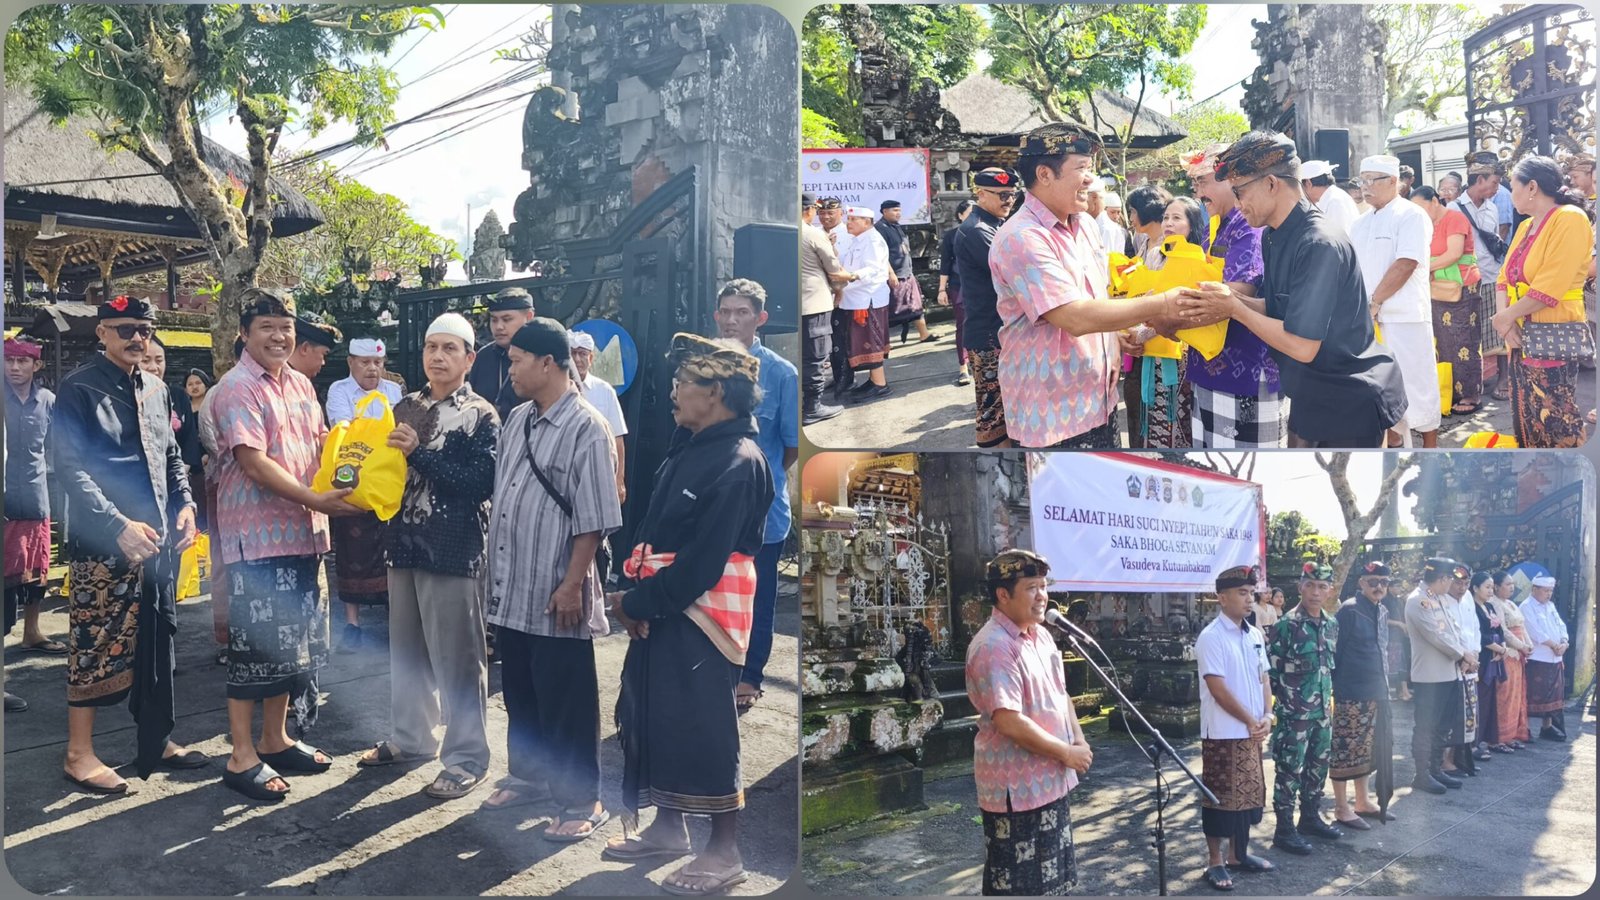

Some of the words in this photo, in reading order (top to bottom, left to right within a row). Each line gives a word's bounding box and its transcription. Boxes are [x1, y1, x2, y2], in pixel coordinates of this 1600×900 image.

[802, 183, 822, 192] EPI
[824, 182, 865, 191] TAHUN
[867, 181, 895, 190] SAKA
[897, 181, 918, 190] 1948
[1044, 505, 1105, 525] SELAMAT
[1108, 513, 1135, 529] HARI
[1137, 516, 1159, 531] SUCI
[1161, 519, 1188, 534] NYEPI
[1189, 523, 1219, 538] TAHUN
[1220, 527, 1239, 540] SAKA
[1240, 529, 1252, 542] 1948
[1111, 535, 1139, 550] SAKA
[1140, 537, 1174, 552] BHOGA
[1175, 541, 1216, 555] SEVANAM
[1121, 557, 1160, 571] Vasudeva
[1162, 559, 1211, 573] Kutumbakam
